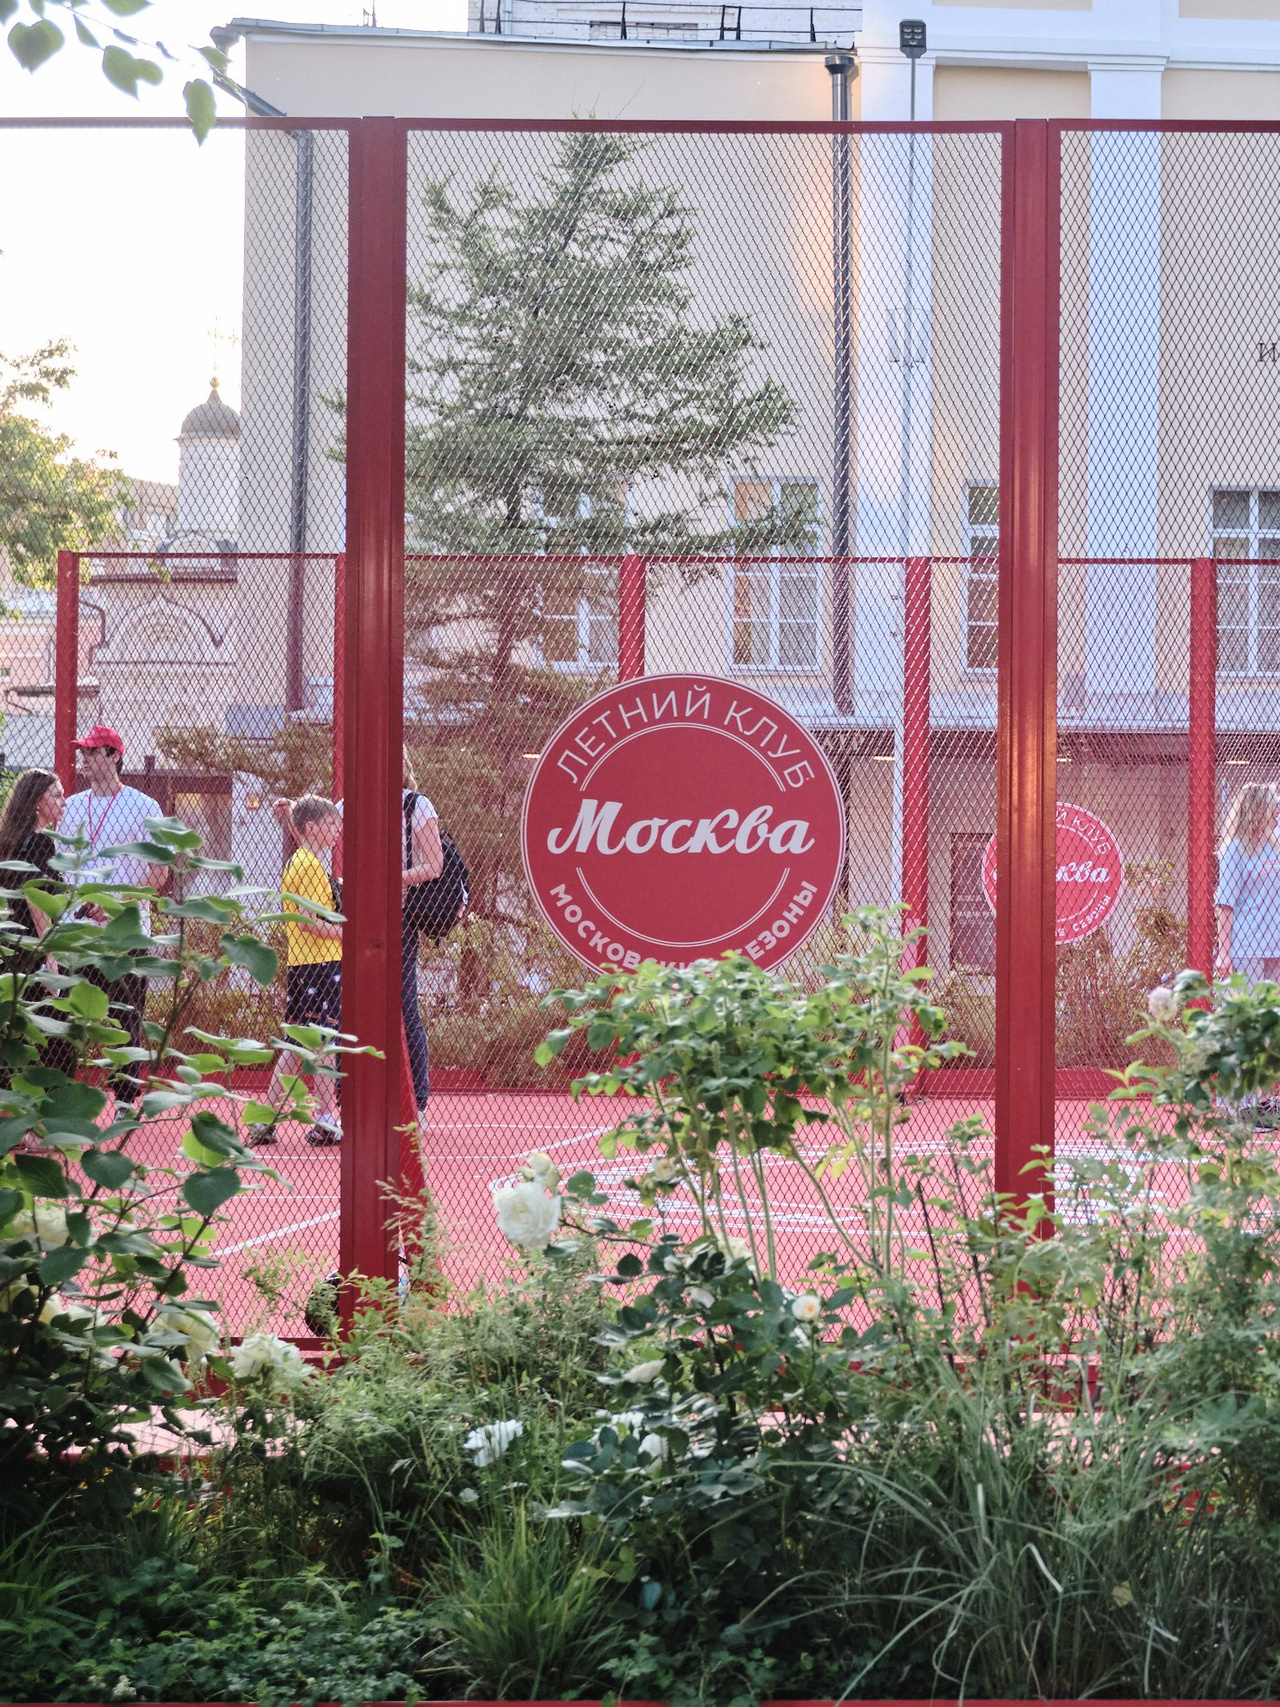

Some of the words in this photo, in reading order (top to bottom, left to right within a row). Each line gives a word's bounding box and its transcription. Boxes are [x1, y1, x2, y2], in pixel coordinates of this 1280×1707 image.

[557, 684, 711, 784] ЛЕТНИЙ
[724, 700, 815, 788] КЛУБ
[547, 798, 815, 854] Москва
[1072, 815, 1111, 854] КЛУБ
[550, 883, 698, 971] МОСКОВ
[733, 880, 818, 961] ЕЗОНЫ
